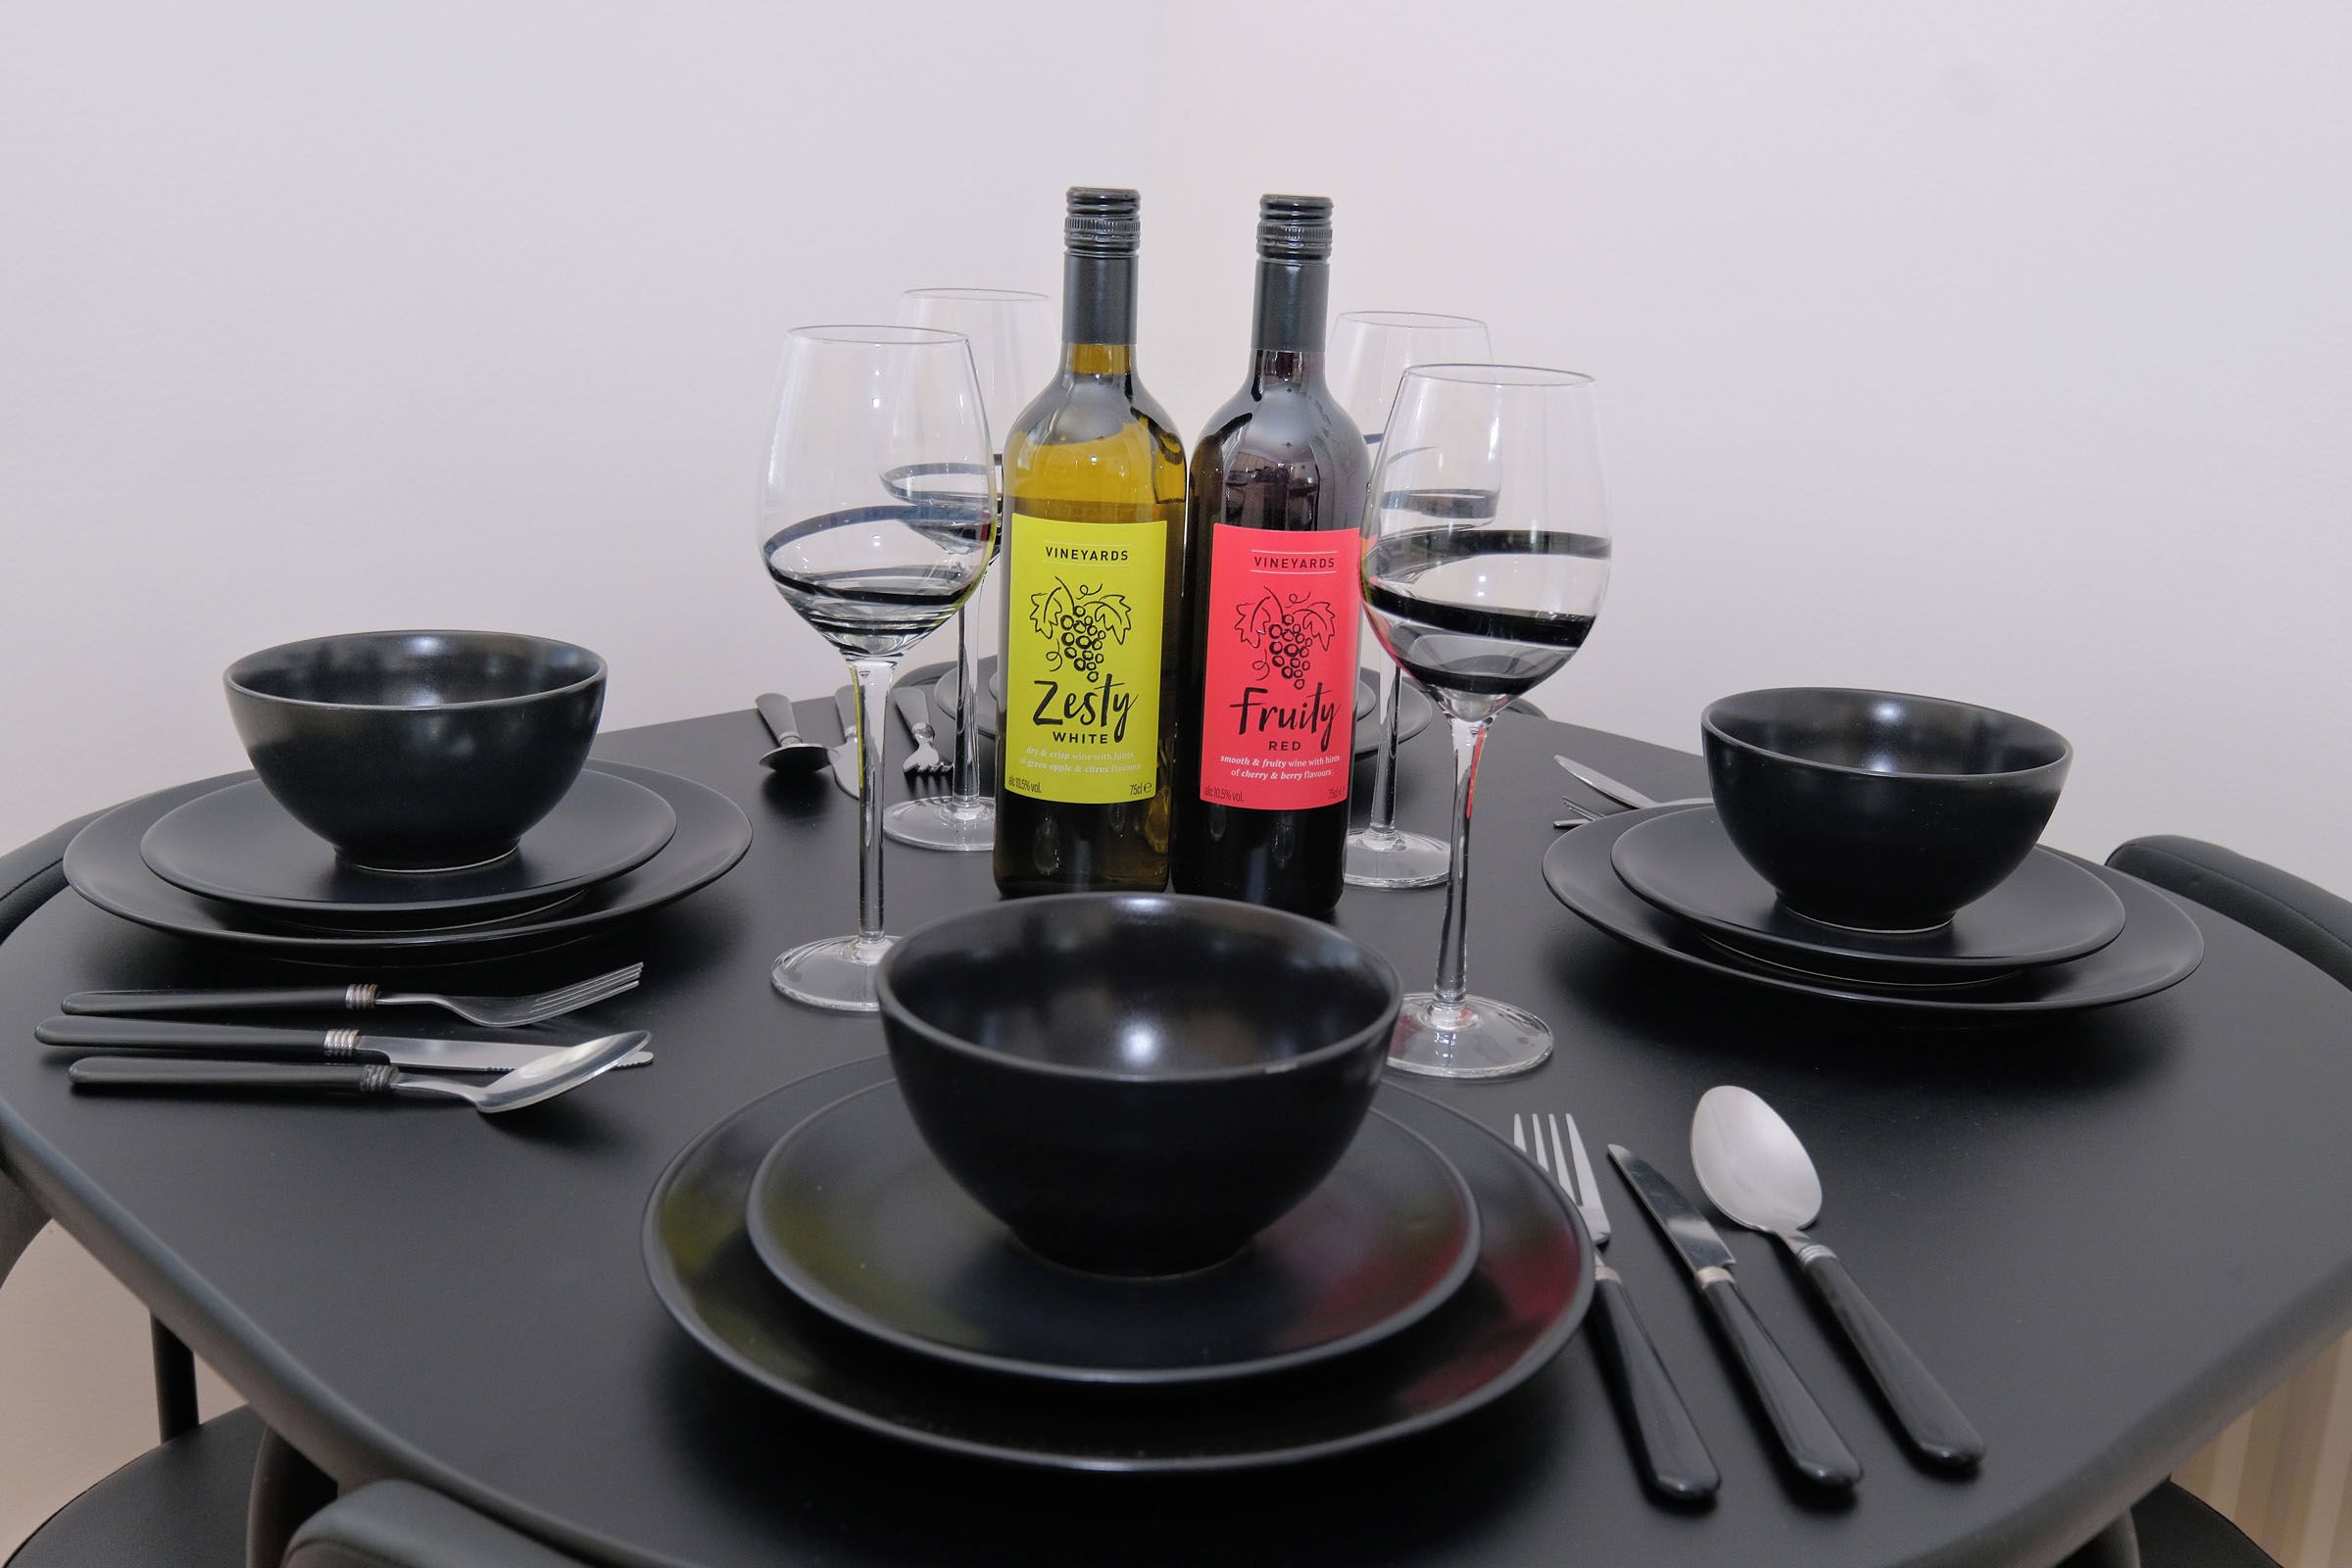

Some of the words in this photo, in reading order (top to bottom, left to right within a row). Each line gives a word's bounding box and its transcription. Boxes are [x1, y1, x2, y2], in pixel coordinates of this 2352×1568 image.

[1046, 546, 1128, 562] VINEYARDS
[1254, 556, 1335, 569] VINEYARDS
[1033, 673, 1139, 743] Zesty
[1229, 682, 1341, 753] Fruity
[1053, 731, 1108, 744] WHITE
[1268, 741, 1301, 752] RED
[1050, 751, 1070, 761] crisp
[1072, 752, 1093, 761] wine
[1094, 752, 1112, 761] with
[1113, 751, 1134, 760] hints
[1219, 756, 1250, 766] smooth
[1262, 759, 1287, 769] fruity
[1288, 759, 1307, 768] wine
[1308, 757, 1324, 766] with
[1325, 754, 1340, 763] hints
[1026, 760, 1048, 769] green
[1050, 763, 1072, 773] apple
[1074, 764, 1083, 773] &
[1085, 763, 1109, 773] citrus
[1231, 768, 1240, 777] of
[1241, 769, 1268, 781] cherry
[1270, 771, 1278, 780] &
[1280, 770, 1302, 781] berry
[1129, 783, 1143, 796] 75cl
